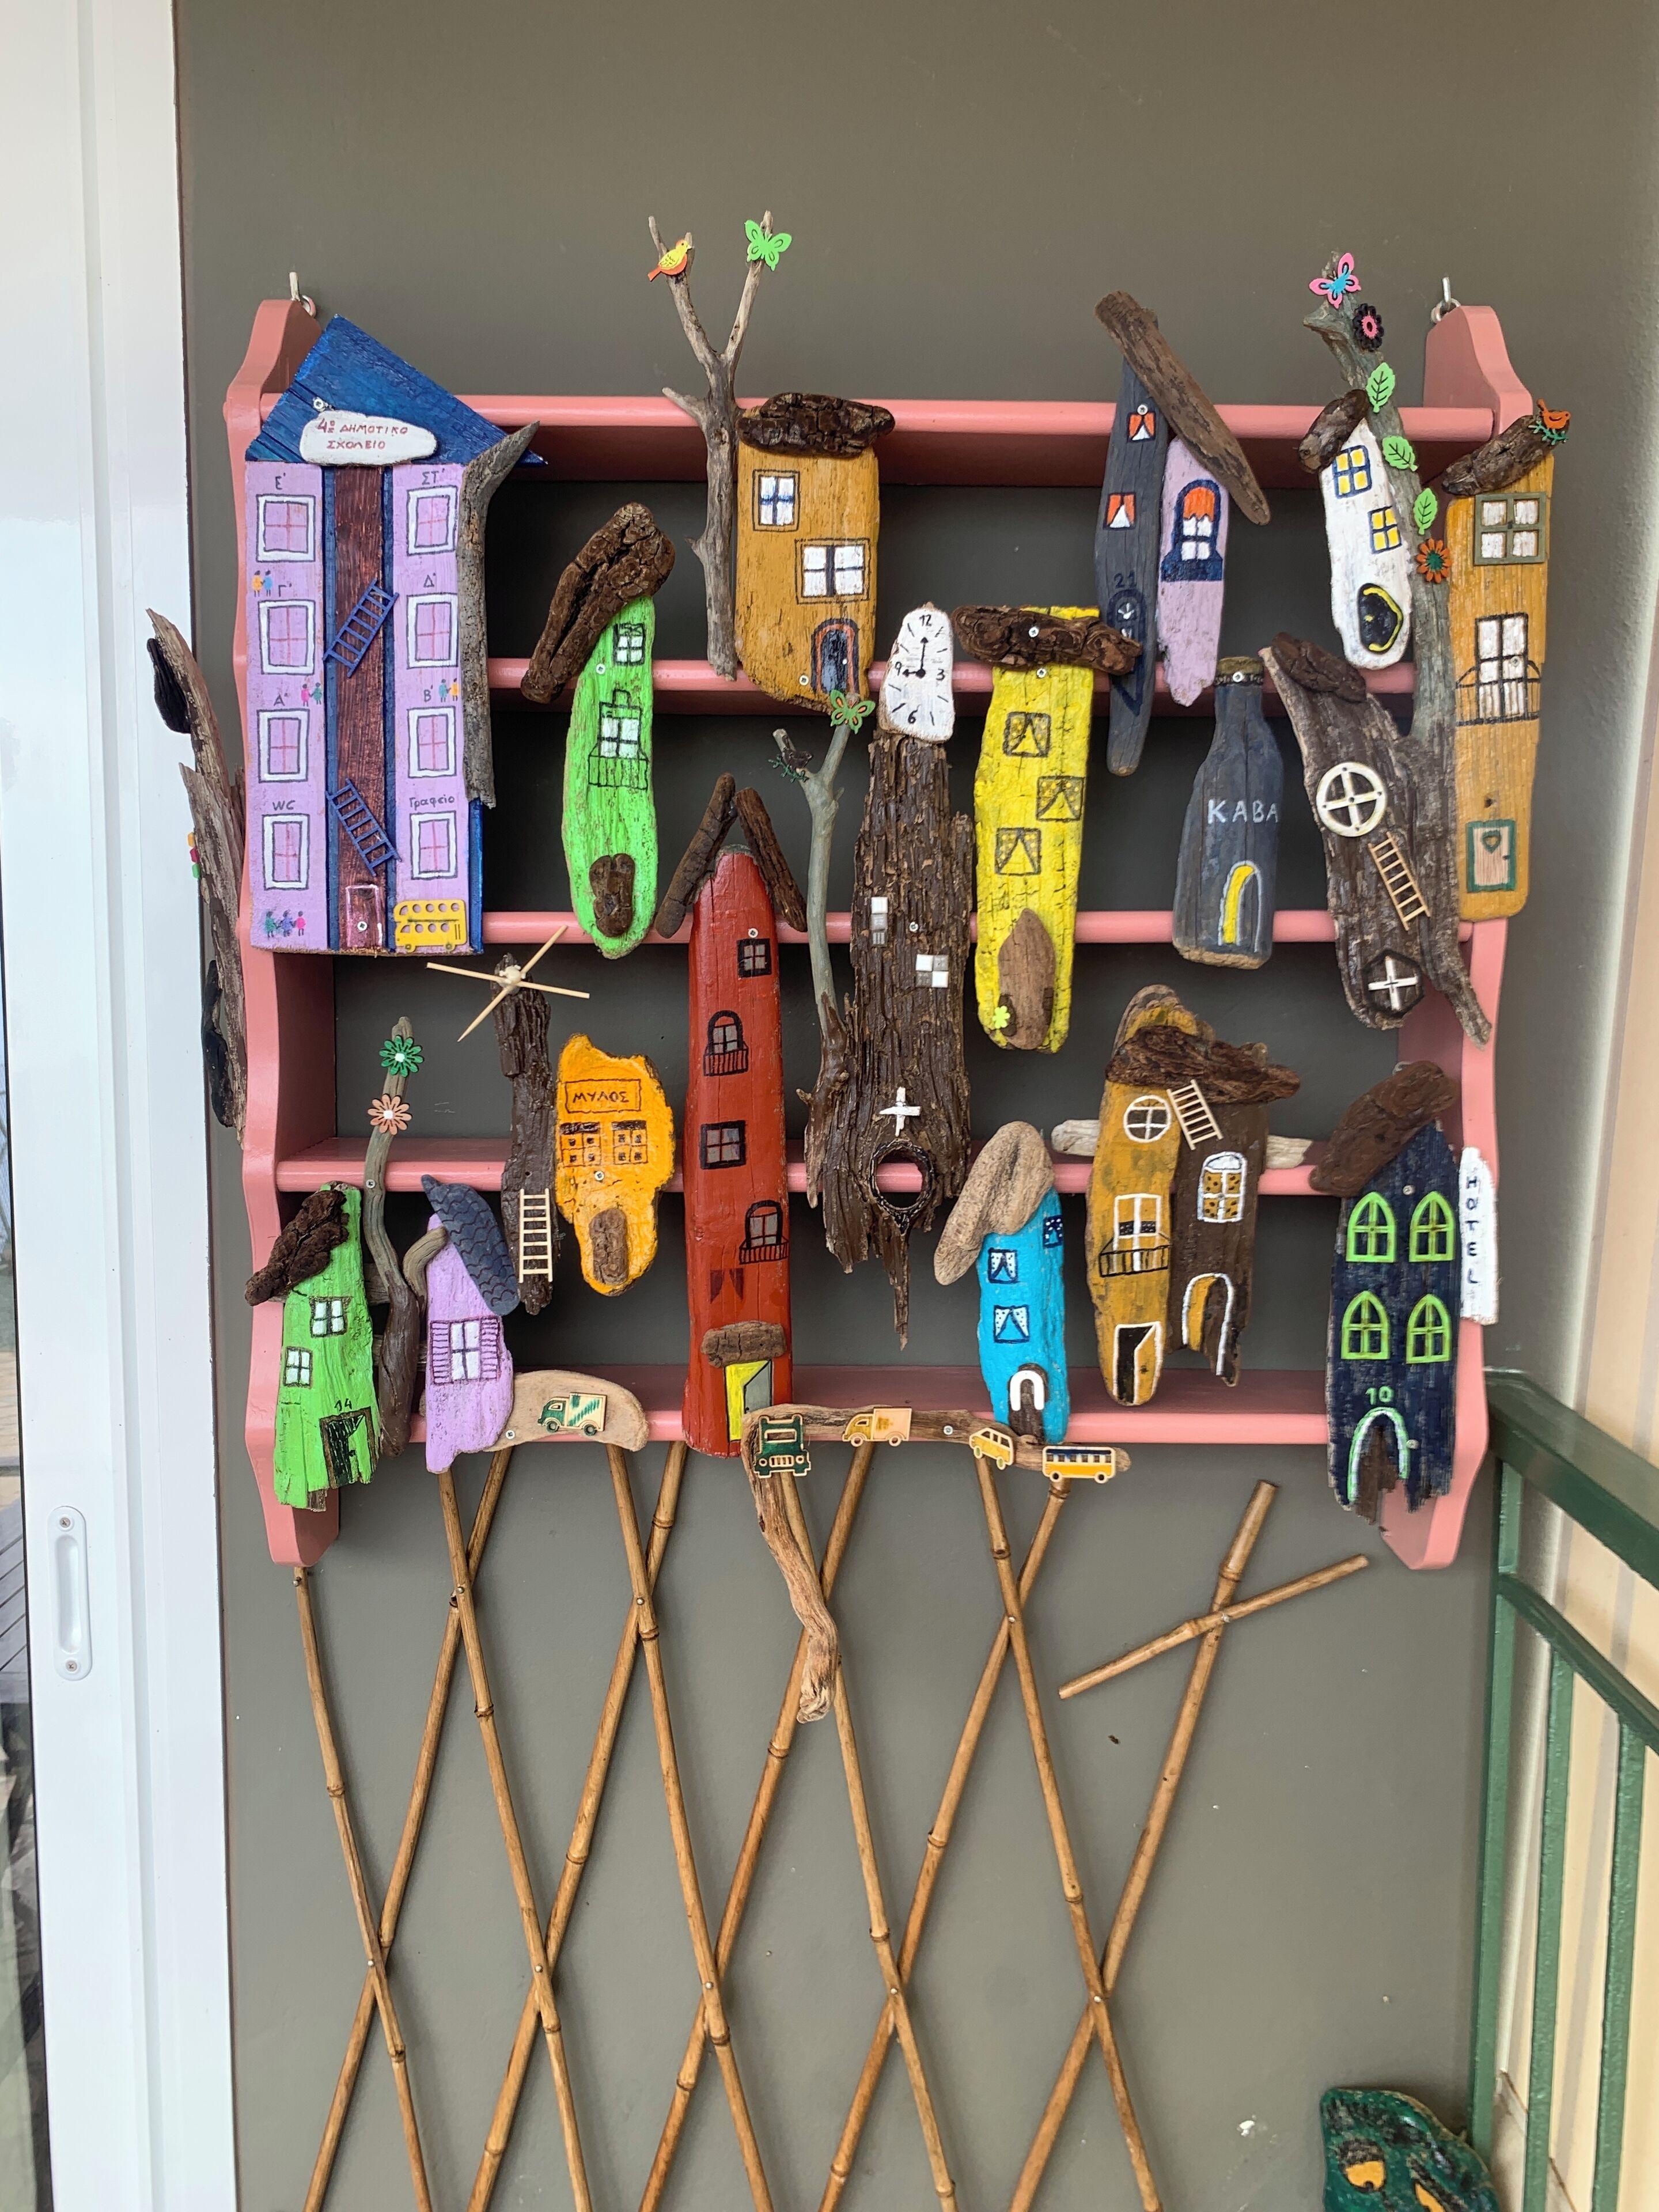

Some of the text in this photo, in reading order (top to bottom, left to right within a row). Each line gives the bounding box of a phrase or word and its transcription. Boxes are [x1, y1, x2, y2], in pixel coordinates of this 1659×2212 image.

[340, 424, 408, 435] ΔΗΜΟΤΙΚΟ
[327, 440, 385, 449] ΣΧΟΛΕΙΟ
[919, 614, 932, 627] 12
[895, 662, 901, 676] 9
[936, 669, 945, 681] 3
[908, 704, 922, 724] 6
[272, 800, 296, 811] WC
[1465, 1175, 1481, 1284] HOTEL
[1364, 1385, 1393, 1406] 10
[334, 1398, 353, 1411] 14
